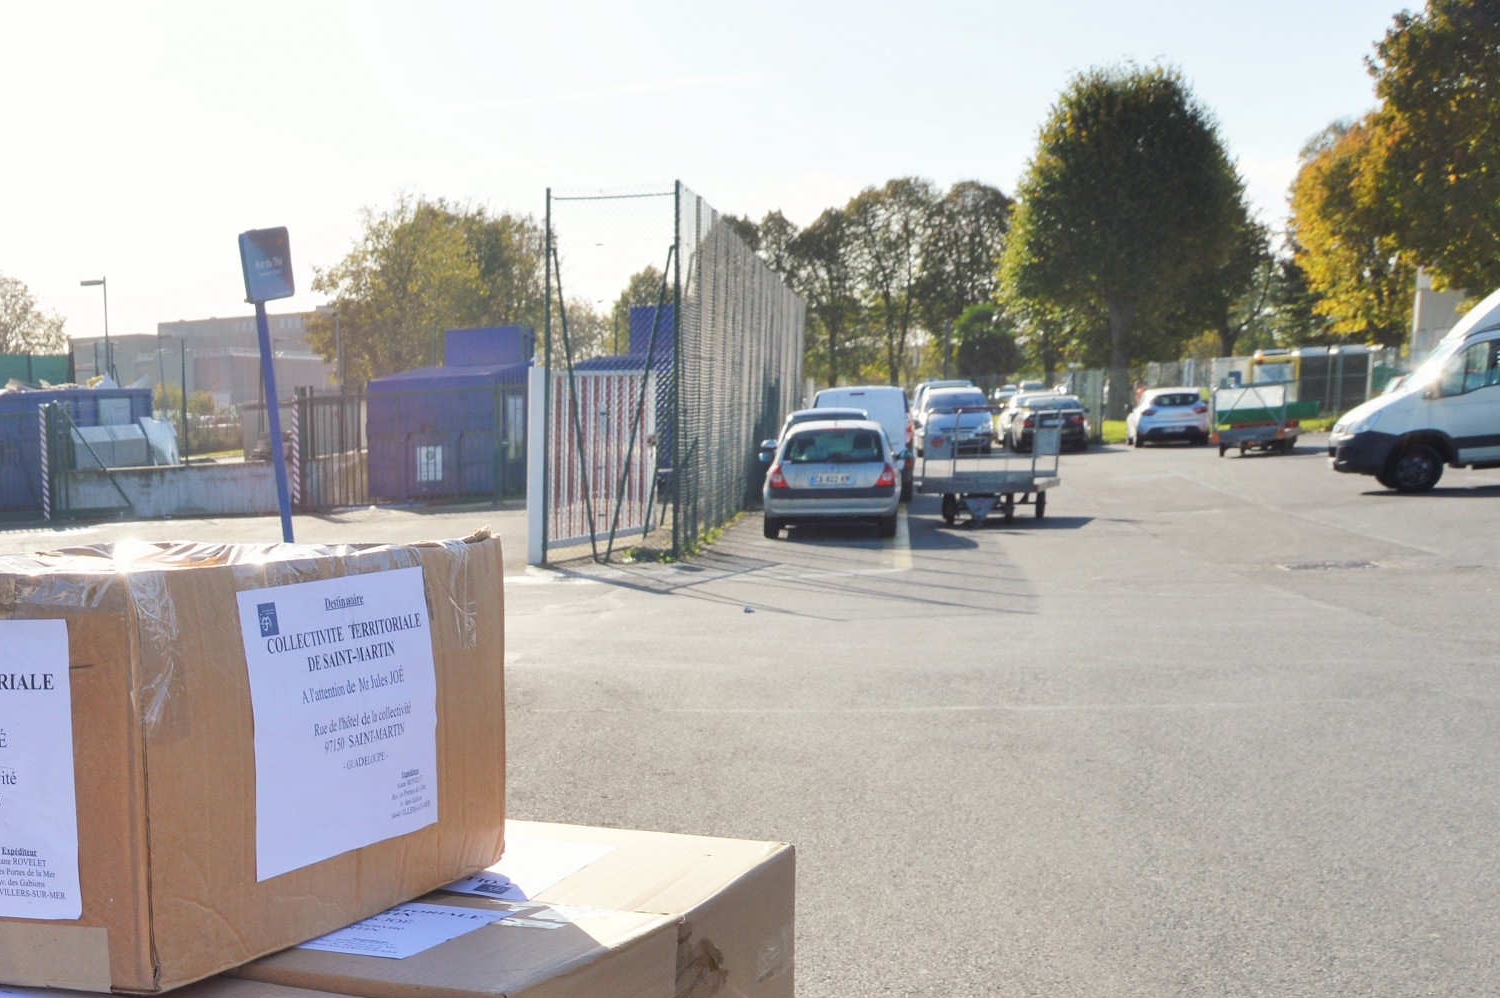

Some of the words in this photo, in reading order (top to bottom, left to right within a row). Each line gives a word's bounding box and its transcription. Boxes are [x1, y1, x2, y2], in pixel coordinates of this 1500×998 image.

[325, 594, 364, 611] Destinataire
[268, 626, 343, 654] COLLECTIVITE
[349, 613, 421, 640] TERRITORIALE
[308, 654, 321, 672] DE
[325, 642, 394, 669] SAINT-MARTIN
[325, 736, 346, 754] 97150
[350, 723, 405, 748] SAINT-MARTIN
